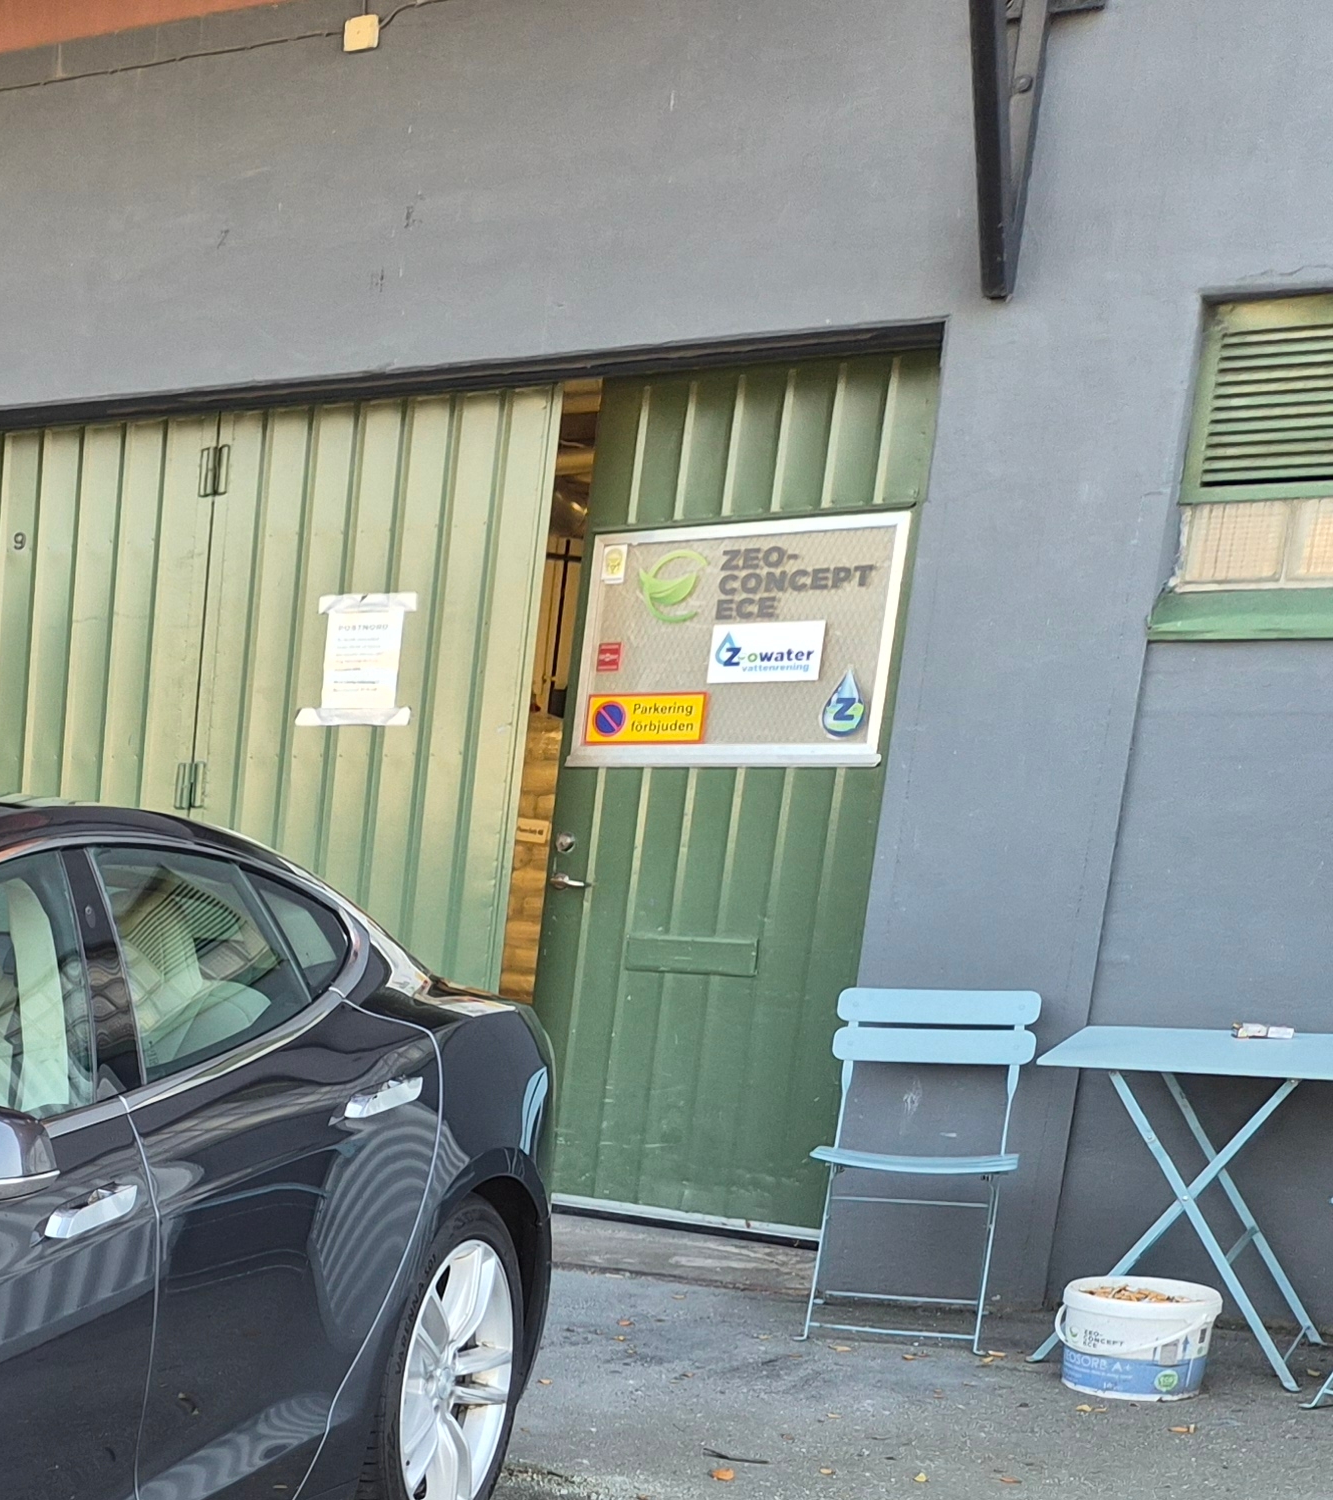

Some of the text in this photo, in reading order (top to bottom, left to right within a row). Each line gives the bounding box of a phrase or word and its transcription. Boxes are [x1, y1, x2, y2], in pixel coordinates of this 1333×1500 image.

[13, 531, 27, 551] 9
[720, 546, 799, 571] ZEO-
[718, 564, 875, 596] CONCEPT
[715, 596, 777, 620] ECE
[742, 662, 810, 673] vattenrening
[633, 703, 693, 717] Parkering
[833, 698, 856, 721] Z
[631, 720, 693, 735] förbjuden
